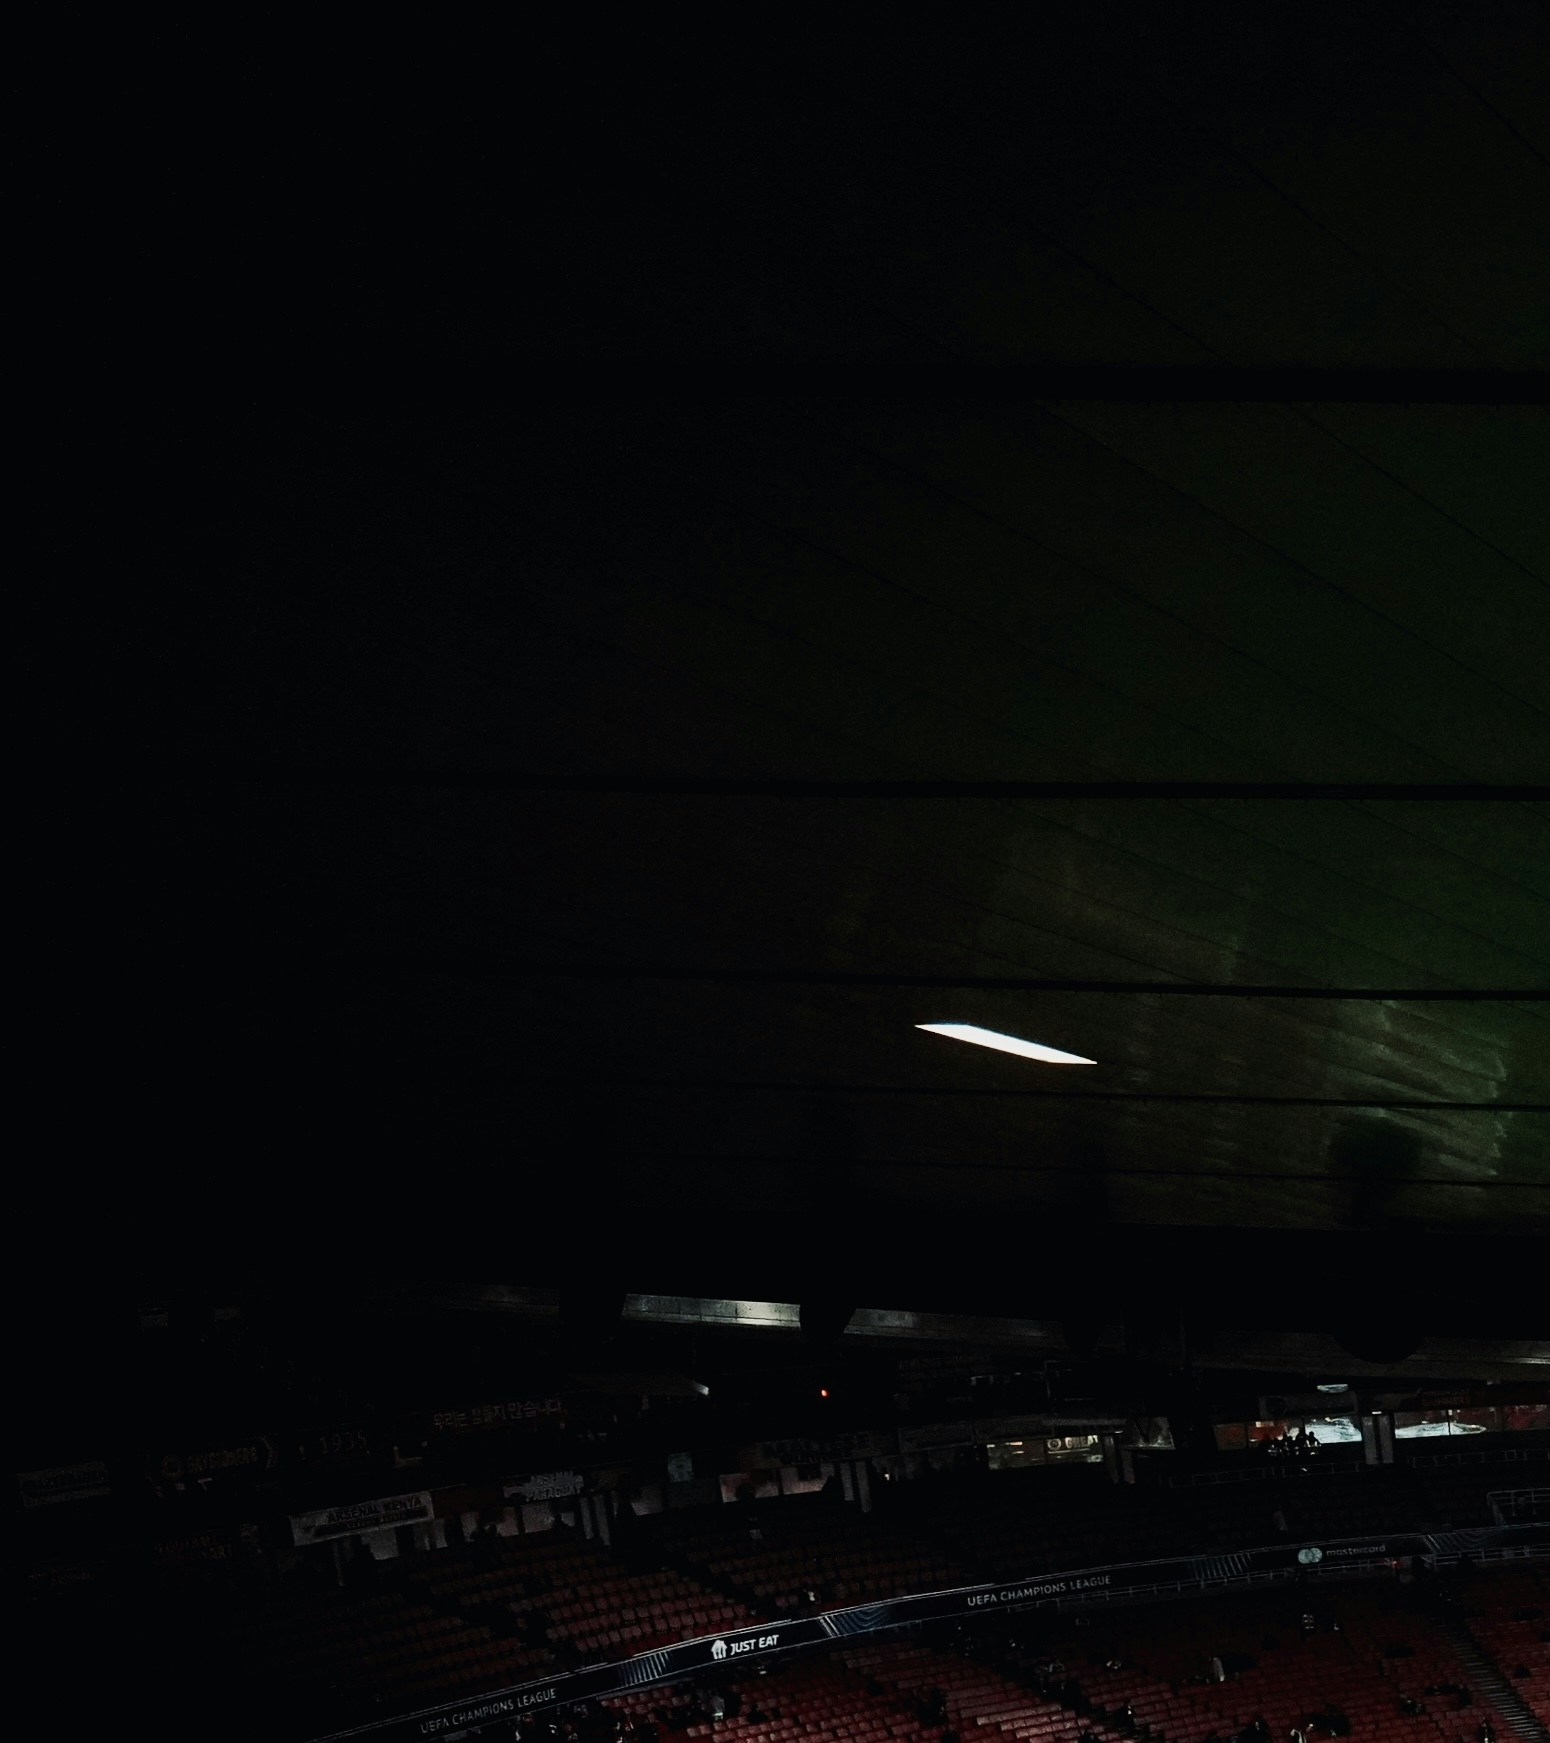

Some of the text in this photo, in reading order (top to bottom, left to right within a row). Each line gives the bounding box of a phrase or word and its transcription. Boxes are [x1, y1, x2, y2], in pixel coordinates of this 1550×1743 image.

[1326, 1544, 1386, 1557] mastercard
[967, 1575, 1112, 1607] UEFA CHAMPIONS LEAGUE
[729, 1634, 780, 1656] JUST EAT
[420, 1688, 558, 1734] UEFA CHAMPIONS LEAGUE
